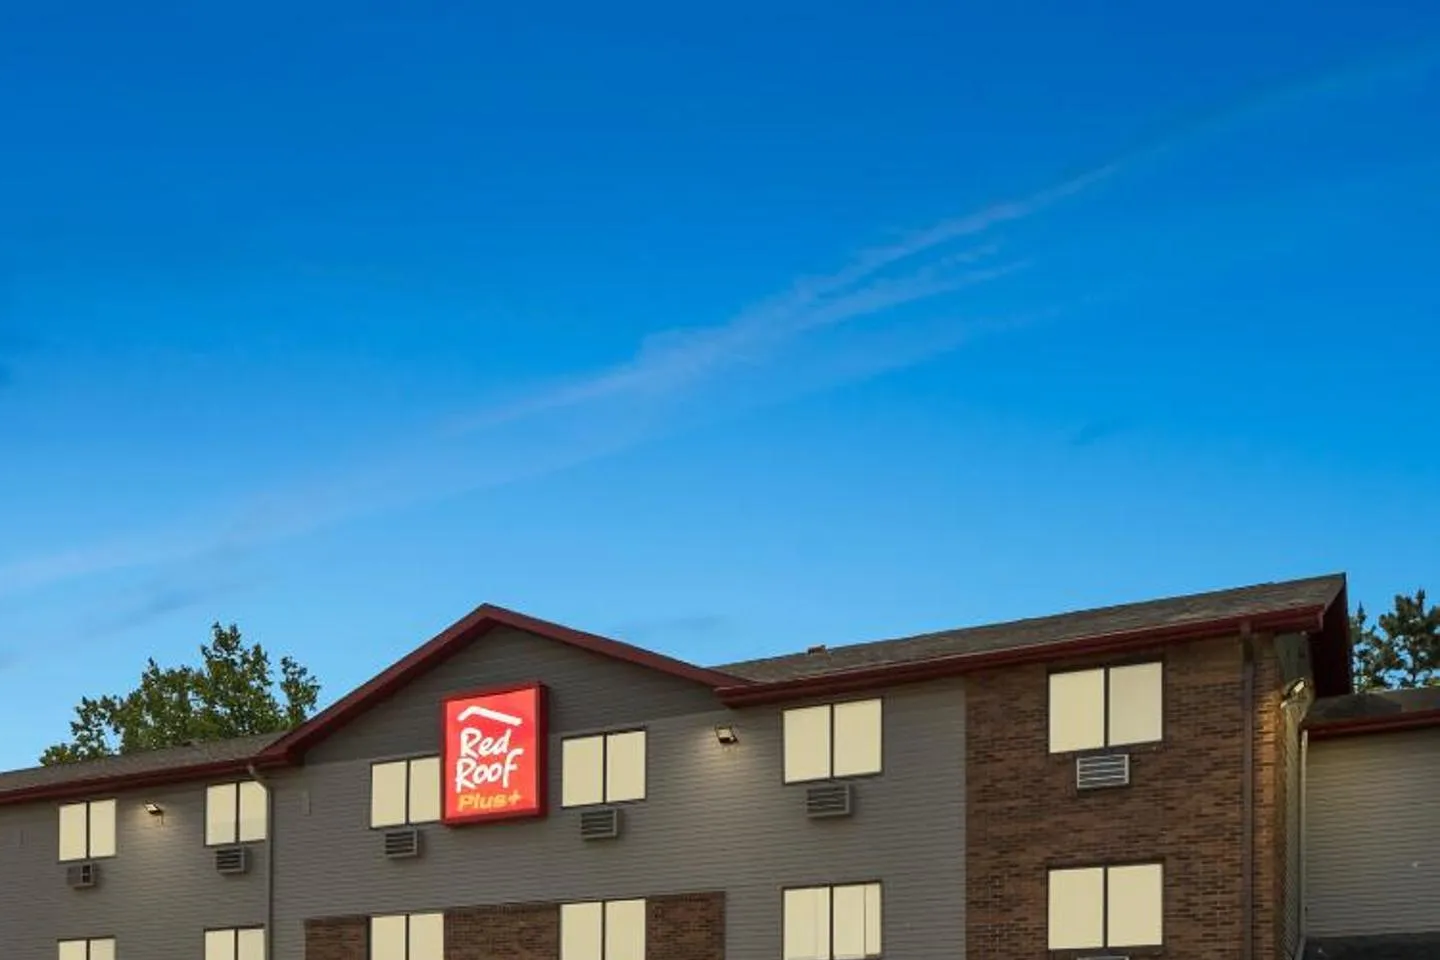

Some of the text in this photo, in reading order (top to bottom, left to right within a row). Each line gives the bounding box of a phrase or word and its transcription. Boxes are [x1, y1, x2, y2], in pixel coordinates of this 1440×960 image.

[461, 727, 512, 759] Red
[456, 748, 523, 793] Roof
[457, 790, 522, 812] Plus+
